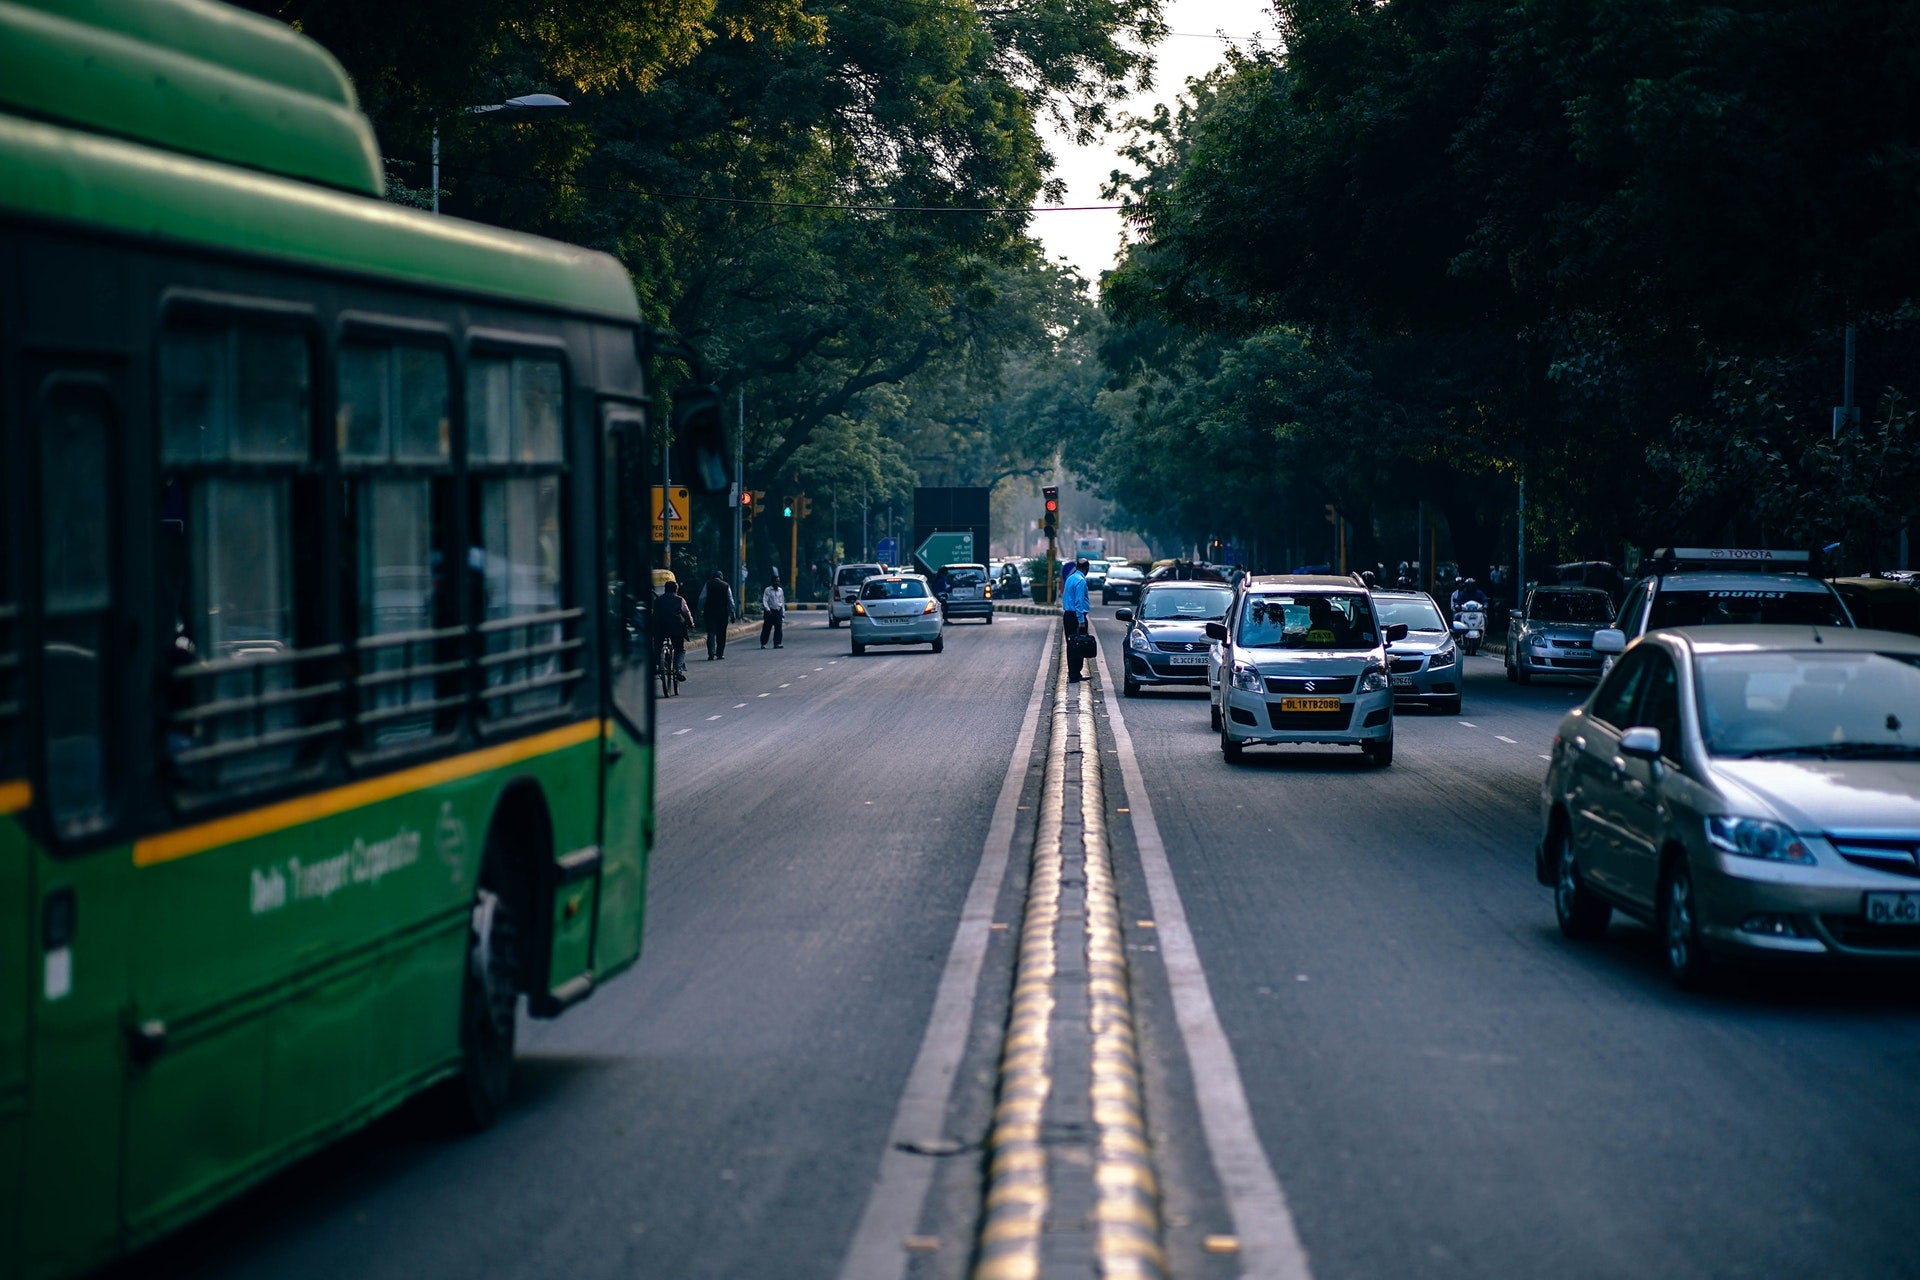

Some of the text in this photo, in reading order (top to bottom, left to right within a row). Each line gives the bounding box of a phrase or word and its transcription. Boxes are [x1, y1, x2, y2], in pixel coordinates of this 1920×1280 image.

[1728, 550, 1772, 559] TOYOTA
[1707, 591, 1788, 600] TOURIST
[1286, 700, 1339, 709] DL1RTB2088
[1872, 902, 1920, 920] DL4C
